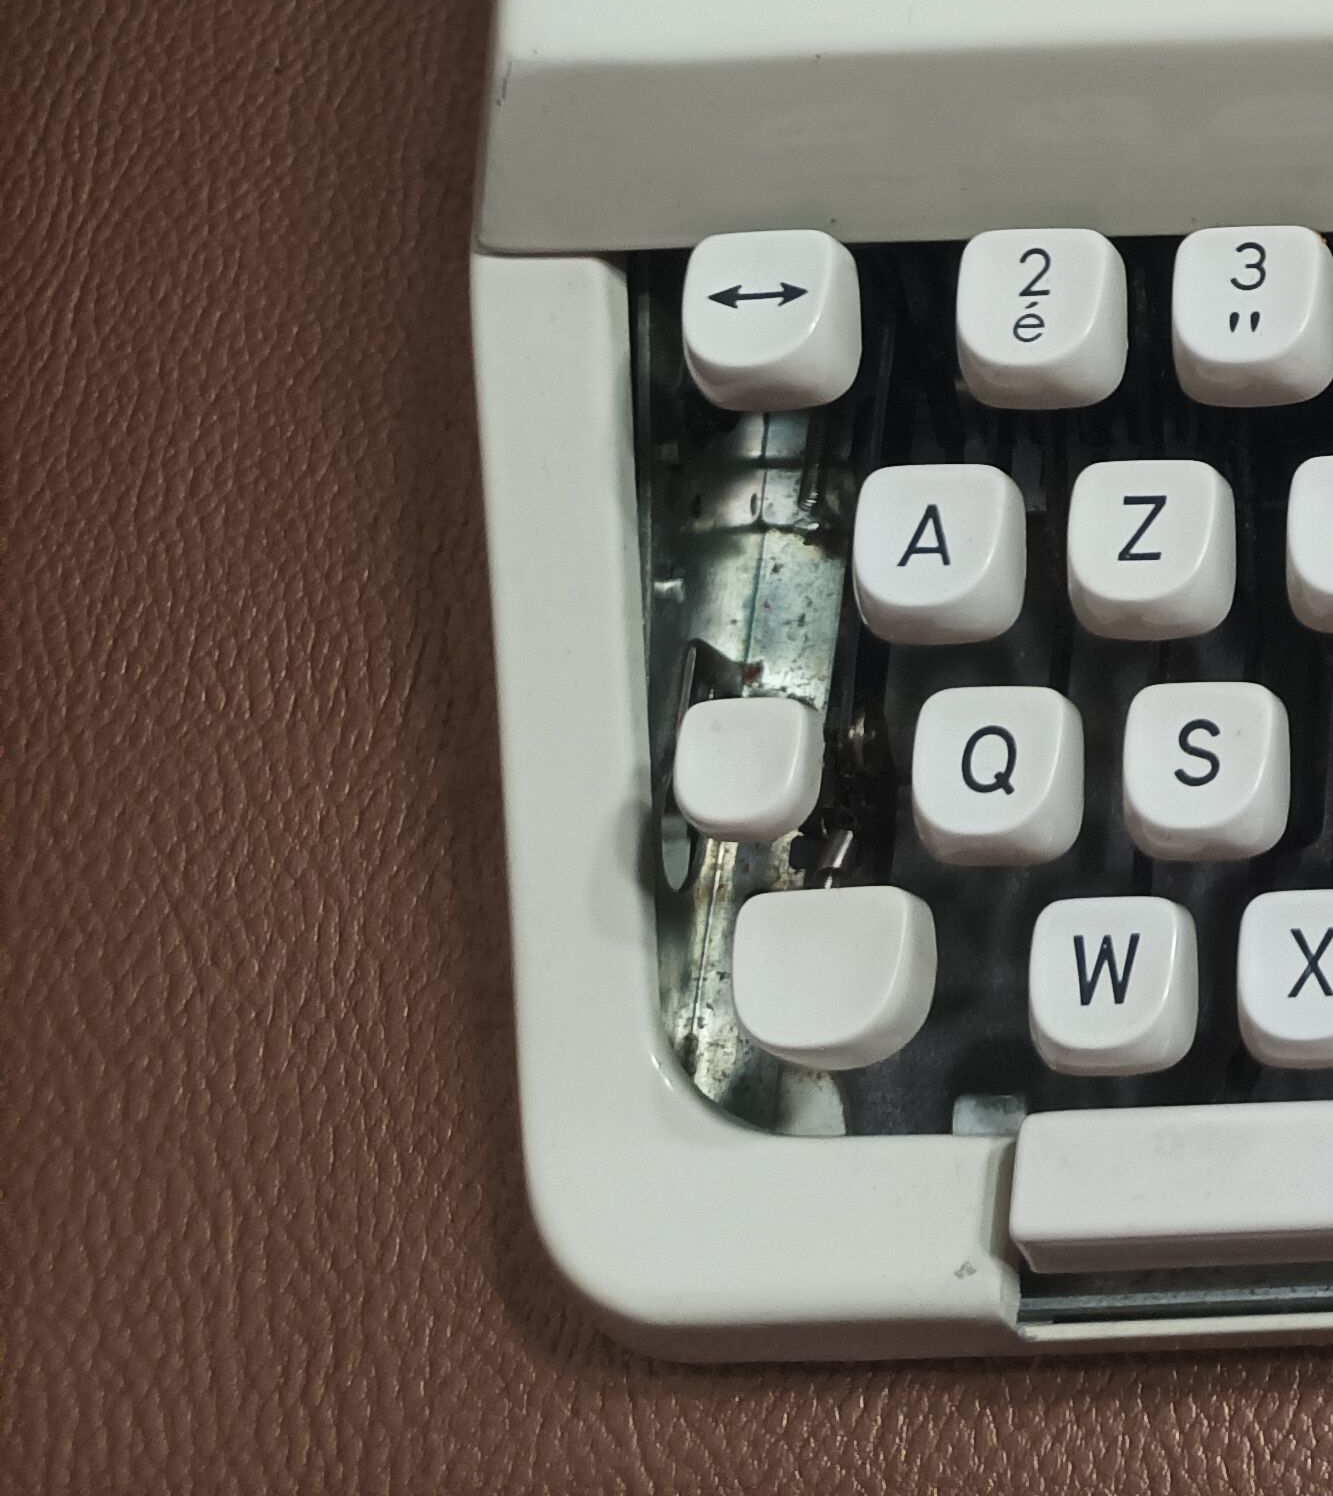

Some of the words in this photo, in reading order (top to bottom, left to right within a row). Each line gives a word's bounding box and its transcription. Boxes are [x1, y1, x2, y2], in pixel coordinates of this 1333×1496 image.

[1018, 248, 1051, 297] 2
[1230, 242, 1266, 291] 3
[1013, 301, 1045, 342] é
[897, 504, 950, 567] A
[1118, 495, 1167, 561] Z
[961, 725, 1017, 795] Q
[1174, 719, 1220, 787] S
[1073, 933, 1140, 1006] W
